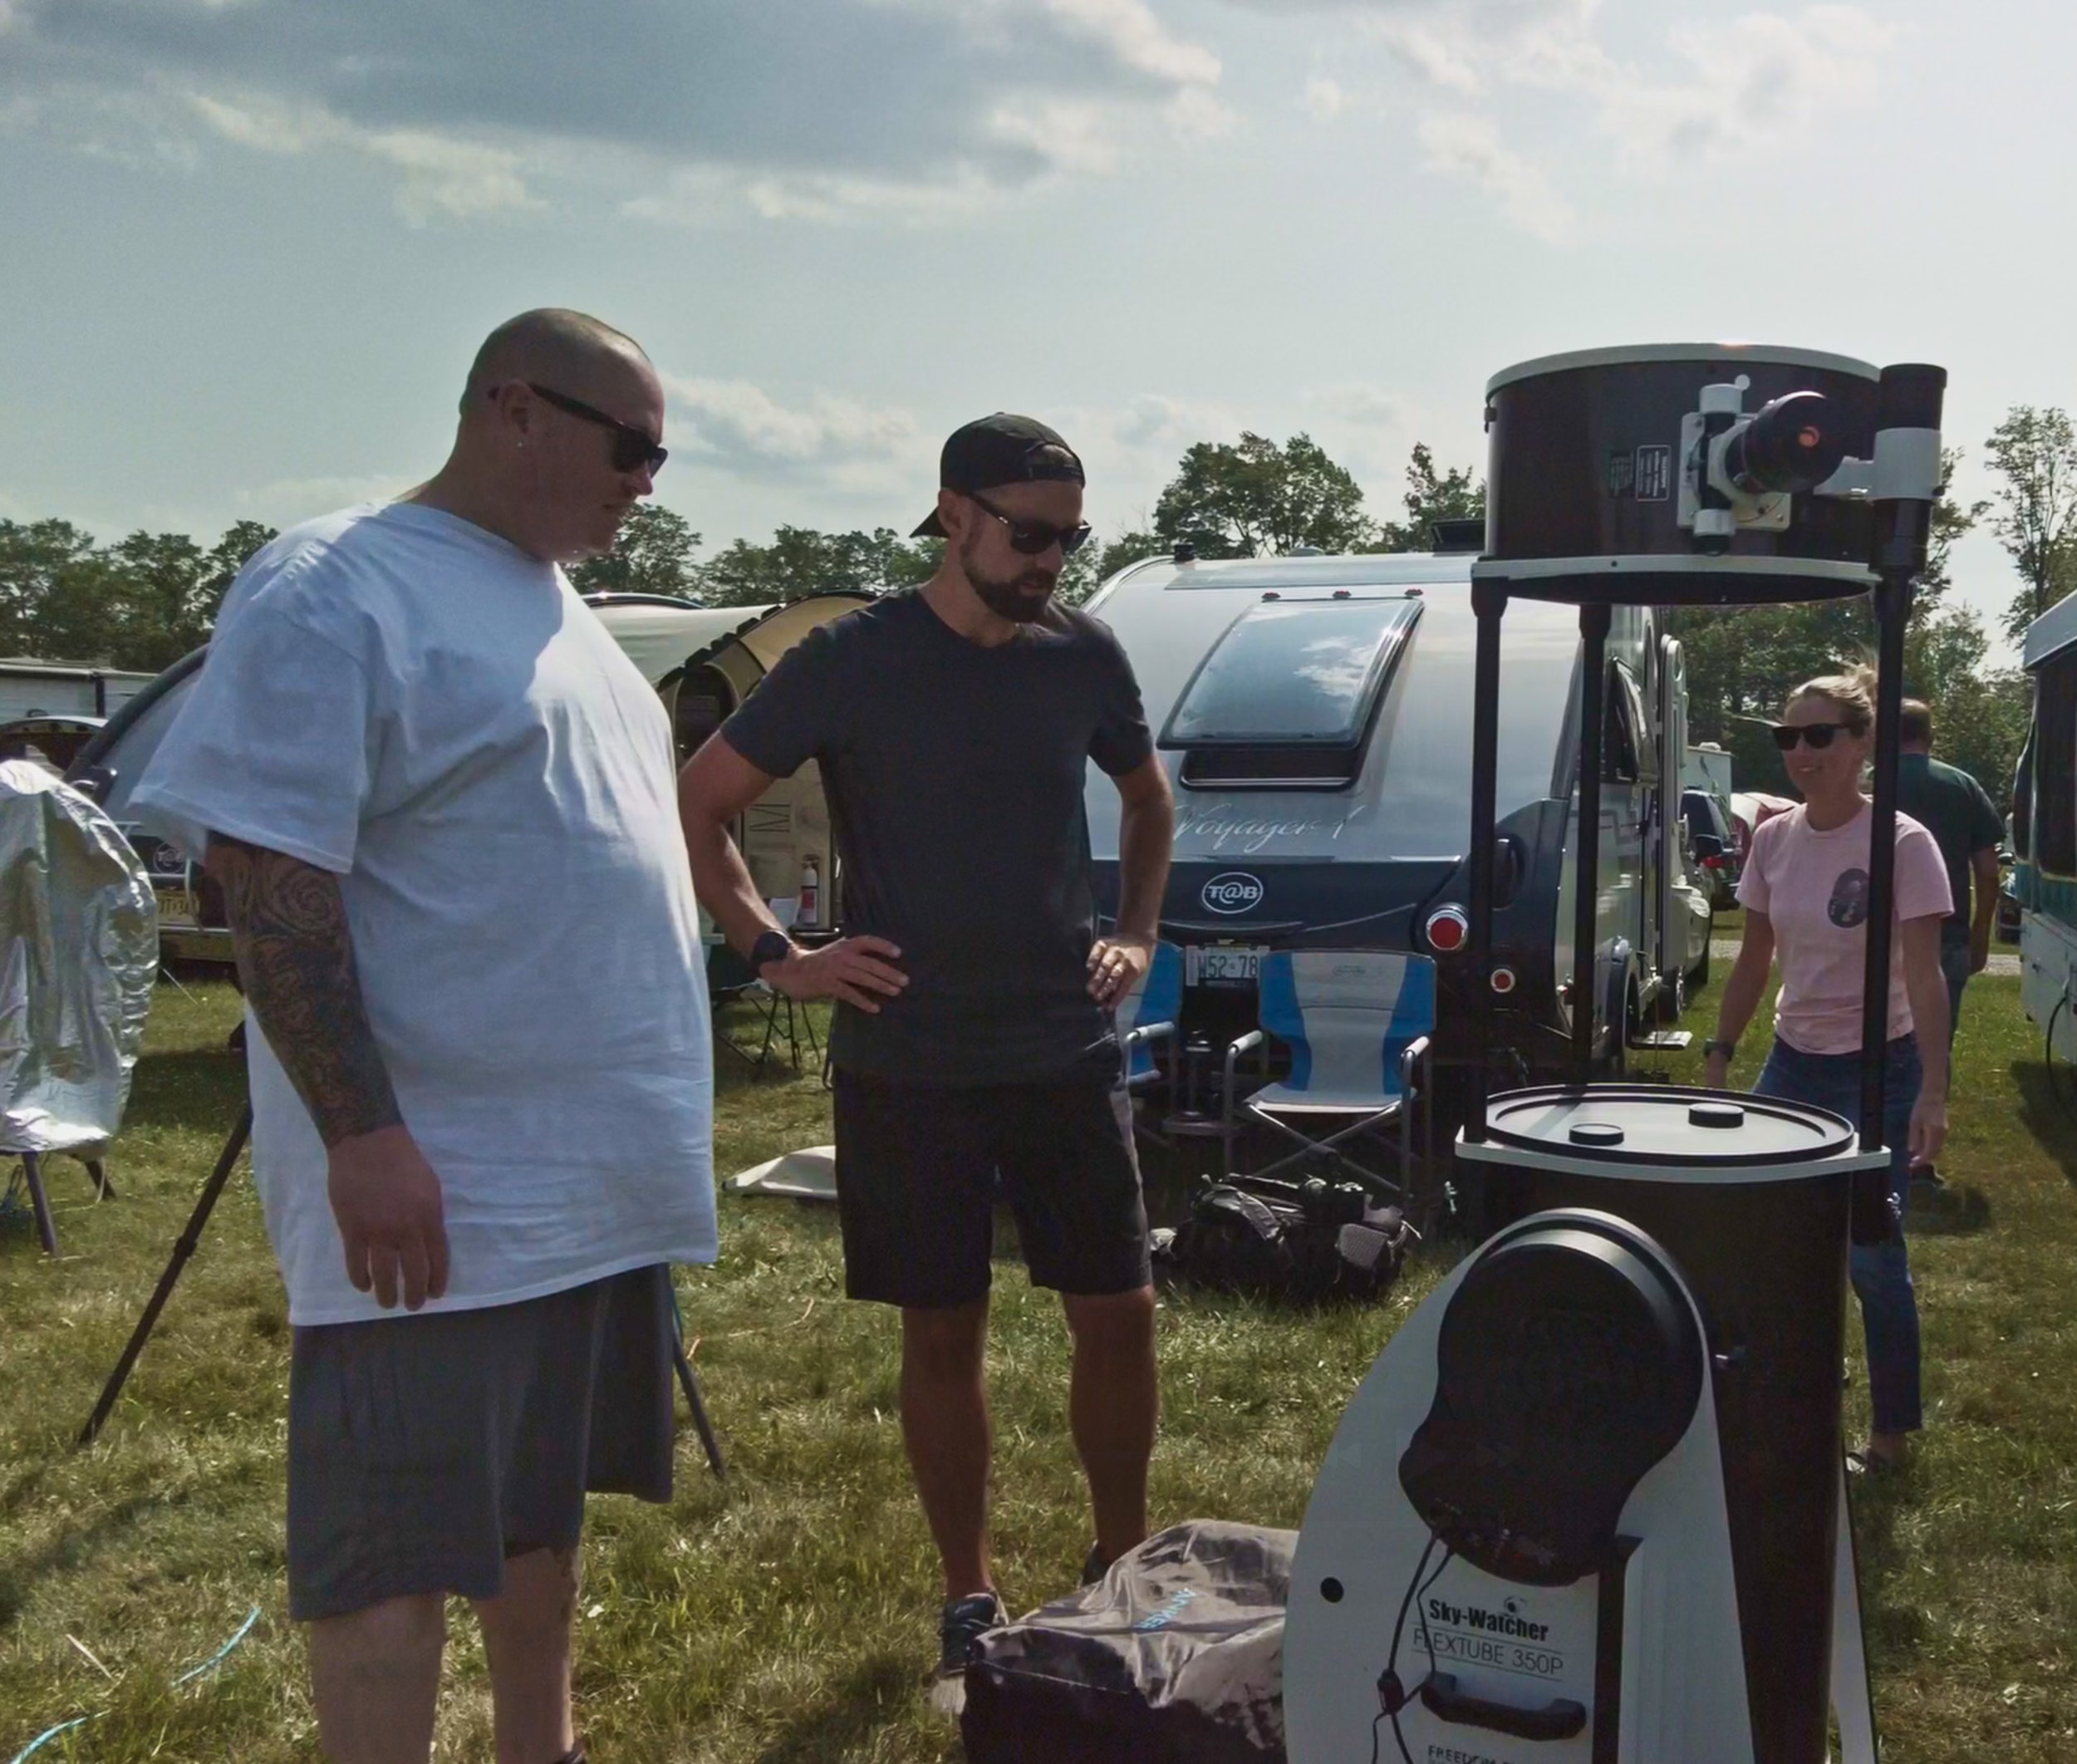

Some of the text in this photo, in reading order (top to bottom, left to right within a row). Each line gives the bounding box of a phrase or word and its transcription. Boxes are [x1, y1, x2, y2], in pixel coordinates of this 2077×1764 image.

[1173, 803, 1321, 853] Voyager
[1208, 882, 1258, 904] T@B
[1430, 1599, 1549, 1642] Sky-Watcher
[1512, 1648, 1564, 1675] 350P
